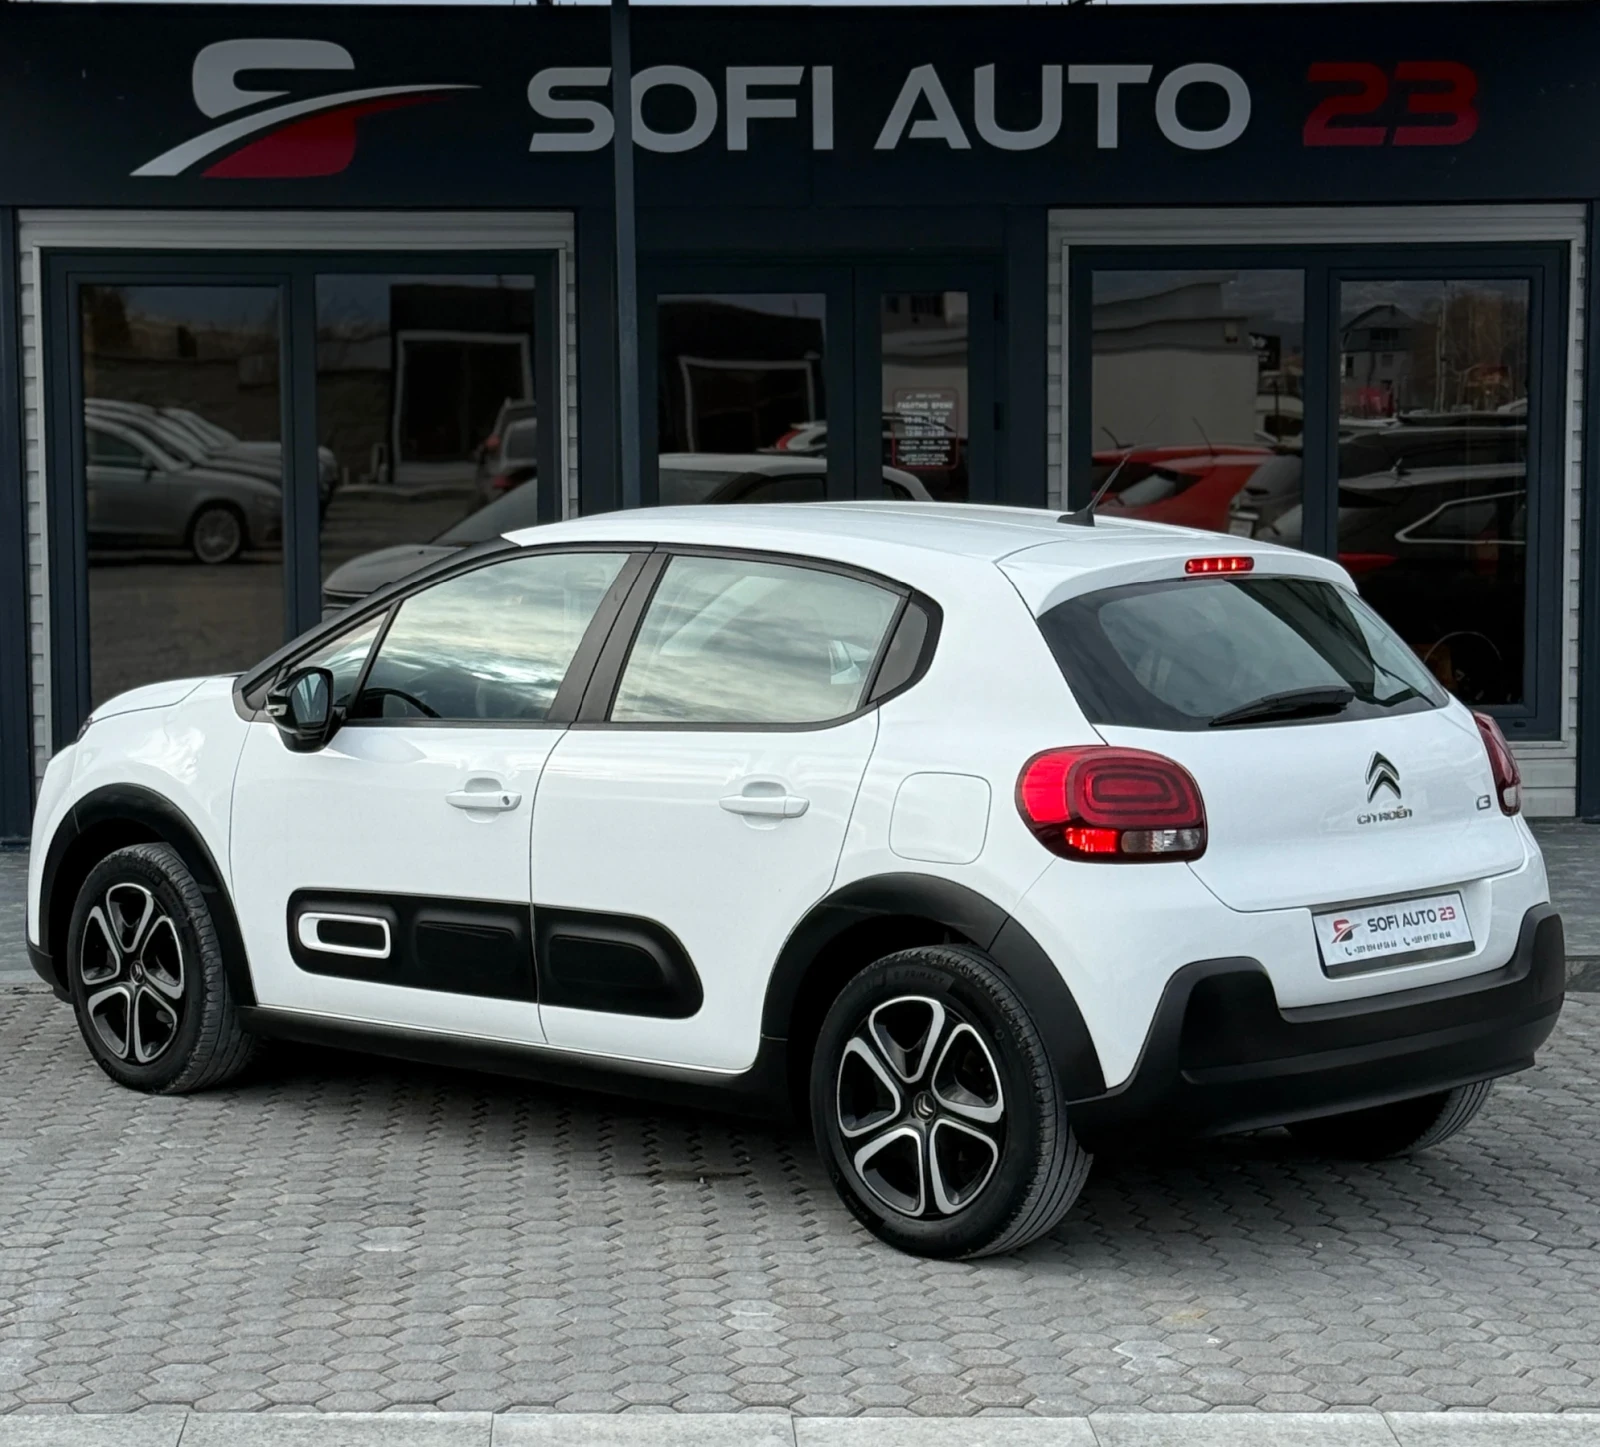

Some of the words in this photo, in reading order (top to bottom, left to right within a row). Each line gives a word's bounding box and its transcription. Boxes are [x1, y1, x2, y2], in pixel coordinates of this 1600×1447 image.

[527, 64, 834, 153] SOFI
[874, 63, 1251, 151] AUTO
[1302, 61, 1480, 148] 23
[1367, 914, 1399, 933] SOFI
[1402, 909, 1437, 928] AUTO
[1438, 906, 1456, 921] 23
